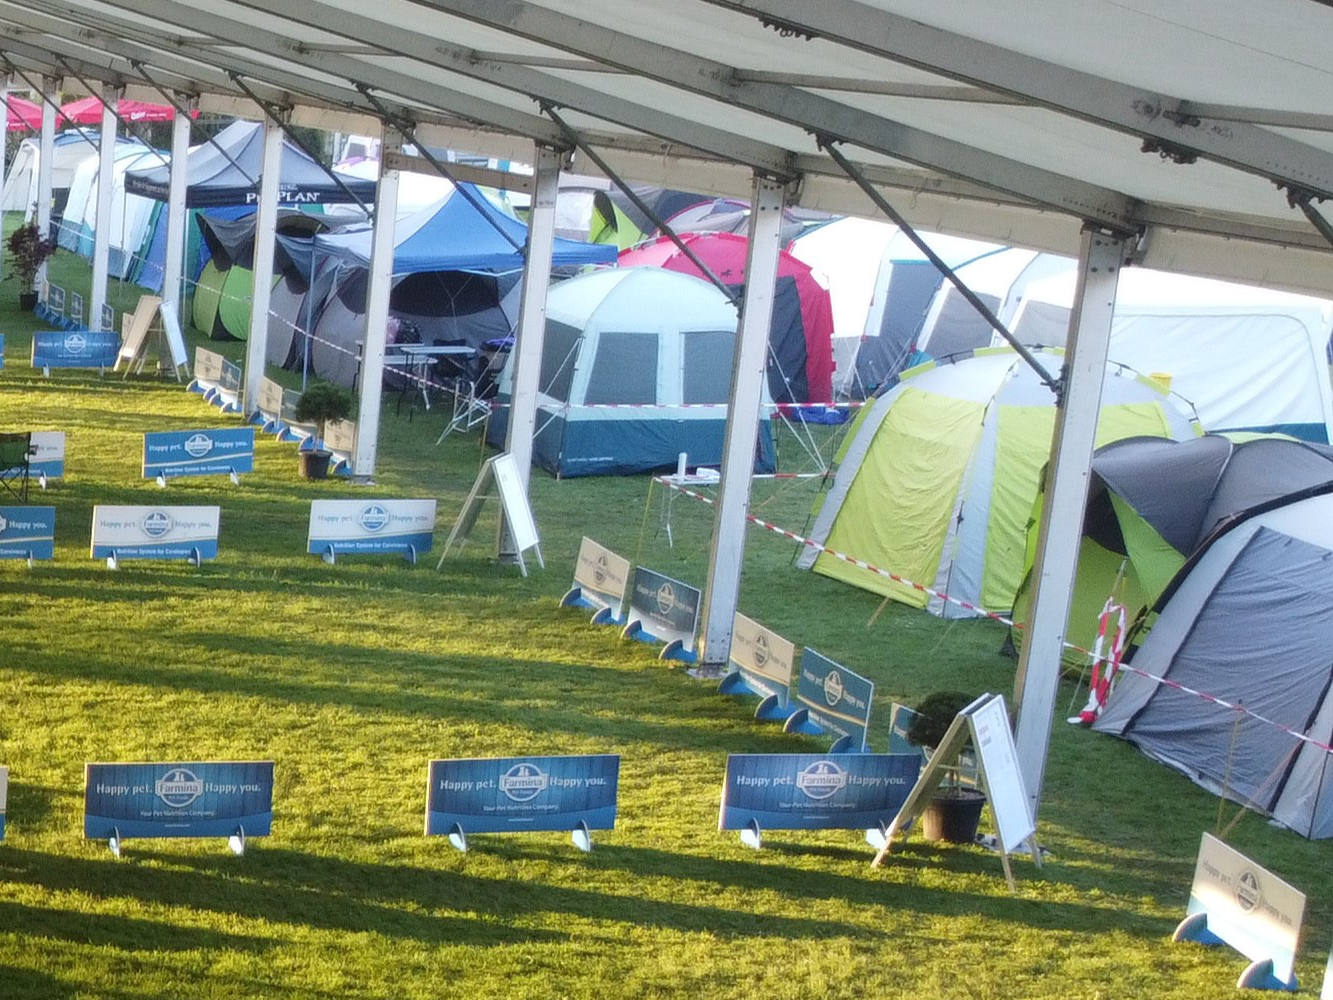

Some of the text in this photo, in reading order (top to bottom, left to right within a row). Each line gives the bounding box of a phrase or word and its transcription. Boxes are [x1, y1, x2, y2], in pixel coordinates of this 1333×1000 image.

[440, 780, 473, 791] Happy
[549, 777, 583, 788] Happy
[737, 776, 770, 787] Happy
[848, 776, 881, 787] Happy
[96, 783, 129, 796] Happy
[205, 782, 237, 794] Happy
